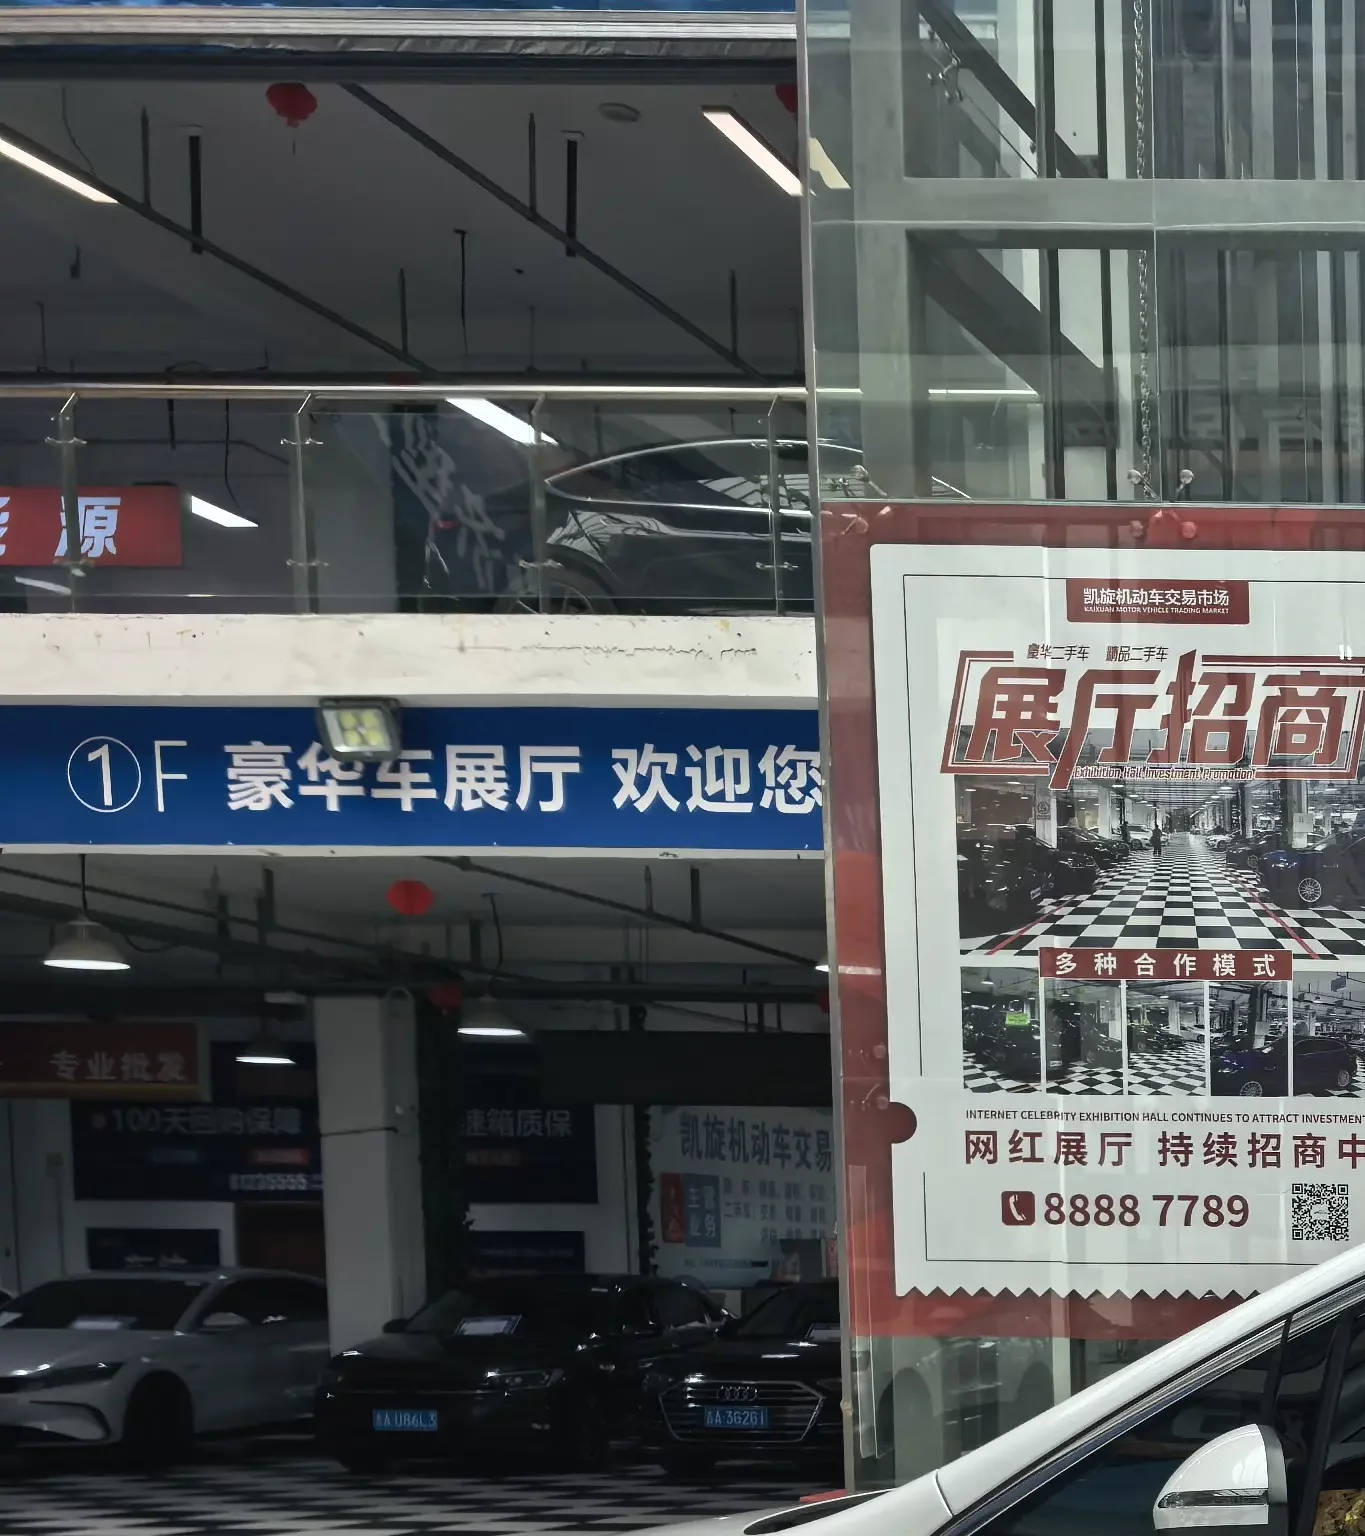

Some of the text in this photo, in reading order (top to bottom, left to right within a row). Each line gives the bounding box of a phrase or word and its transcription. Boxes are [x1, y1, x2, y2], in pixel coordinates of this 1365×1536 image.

[1083, 586, 1230, 607] 凯旋机动车交易市场
[1143, 606, 1169, 614] VEHICLE
[224, 741, 582, 814] 豪华车展厅
[611, 741, 824, 815] 欢迎您
[1144, 767, 1201, 779] Investment
[1203, 768, 1254, 780] Promotion
[1055, 952, 1276, 978] 多种合作模式
[48, 1048, 188, 1083] 专业批发
[965, 1109, 1018, 1119] INTERNET
[1020, 1110, 1077, 1121] CELEBRITY
[1078, 1111, 1141, 1121] EXHIBITION
[1142, 1112, 1169, 1121] HALL
[1171, 1113, 1234, 1122] CONTINUES
[1235, 1113, 1251, 1122] TO
[1252, 1114, 1300, 1123] ATTRACT
[678, 1110, 833, 1173] 凯旋机动车交易
[964, 1129, 1133, 1167] 网红展厅
[1044, 1192, 1250, 1228] 8888 7789
